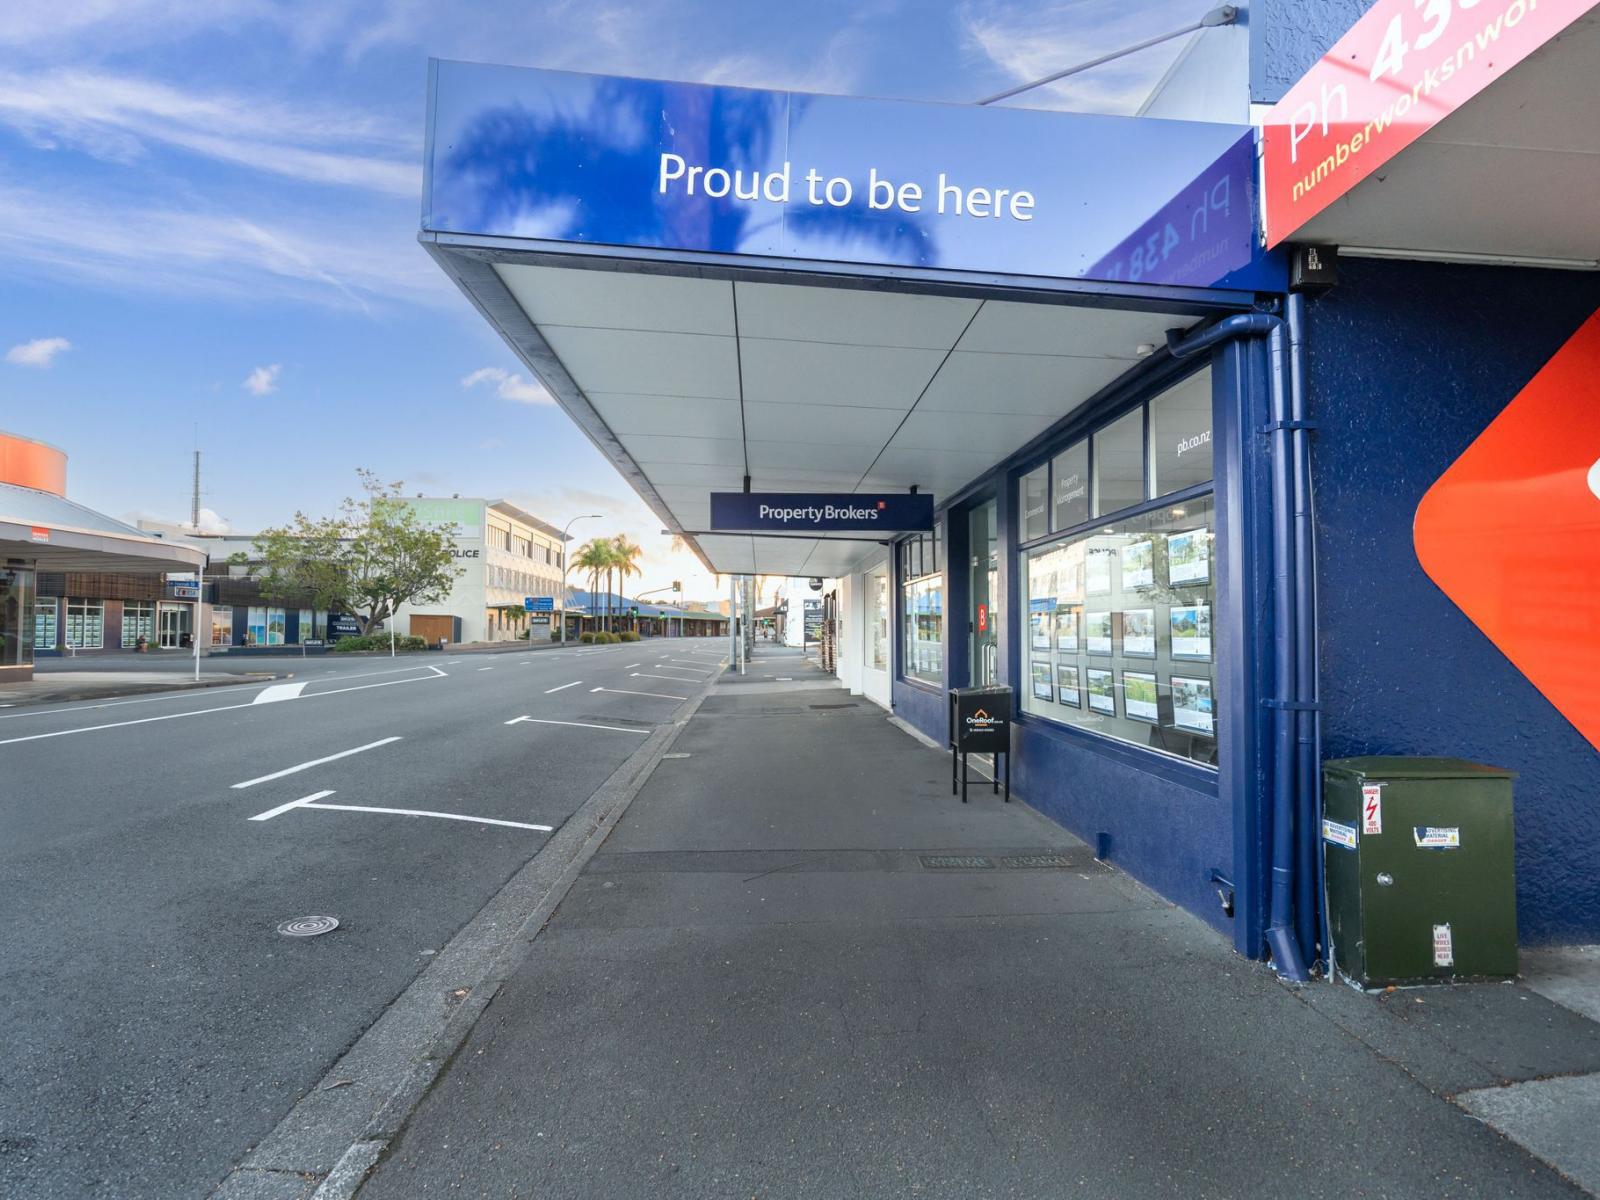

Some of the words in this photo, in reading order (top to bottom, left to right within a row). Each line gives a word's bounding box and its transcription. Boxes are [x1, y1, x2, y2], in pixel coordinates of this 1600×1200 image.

[1288, 80, 1348, 164] Ph
[1369, 0, 1480, 82] 43
[659, 153, 790, 202] Proud
[806, 168, 852, 207] to
[868, 168, 922, 212] be
[937, 173, 1035, 220] here
[1177, 430, 1211, 457] pb.co.nz
[759, 504, 824, 523] Property
[825, 504, 878, 519] Brokers
